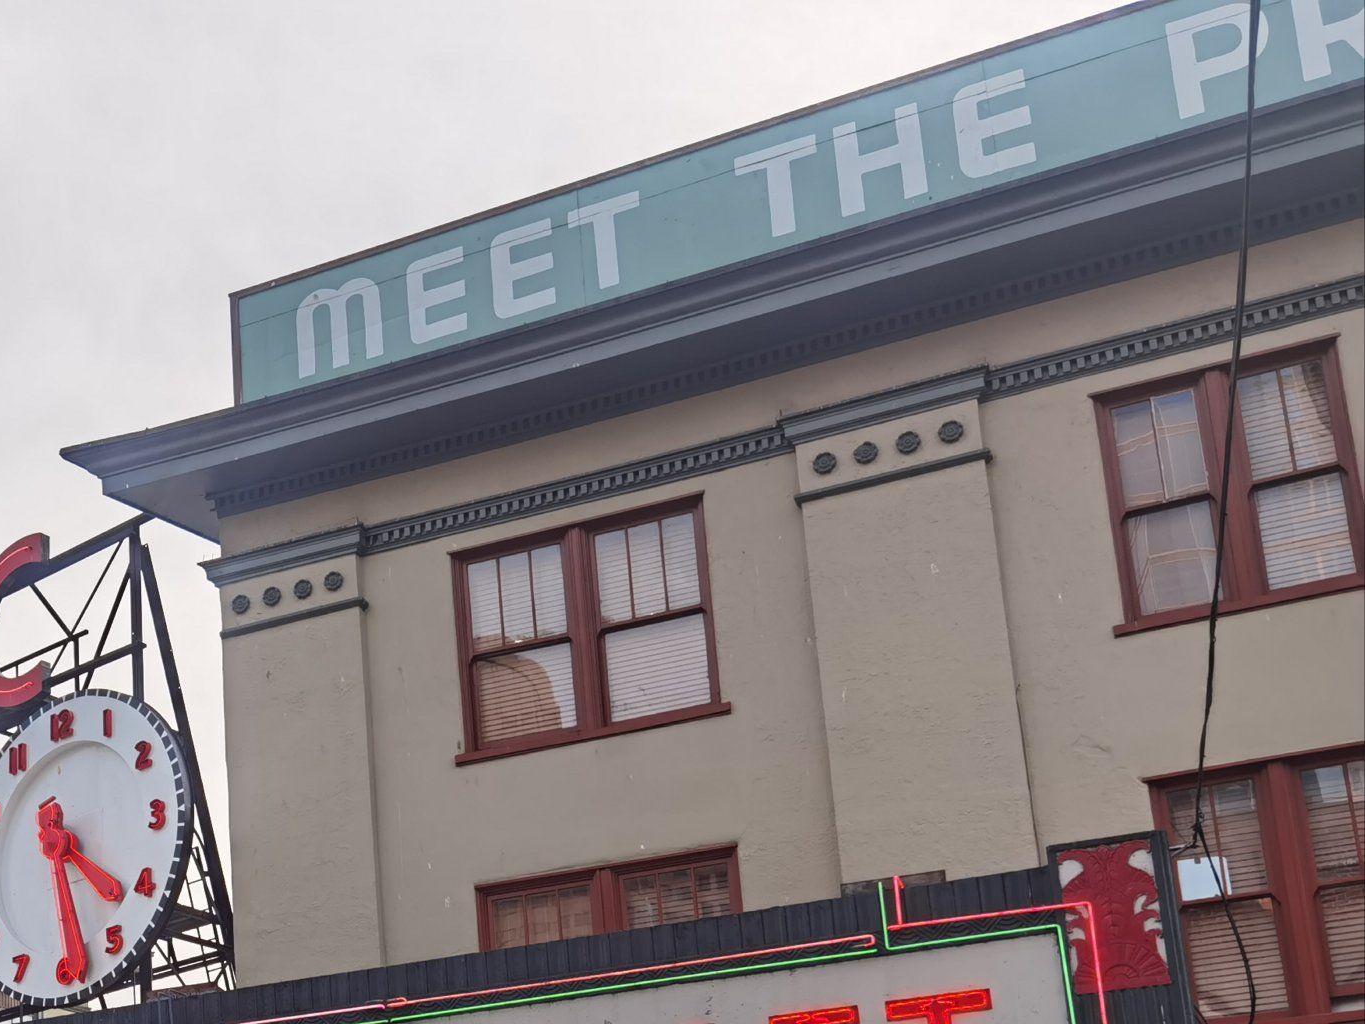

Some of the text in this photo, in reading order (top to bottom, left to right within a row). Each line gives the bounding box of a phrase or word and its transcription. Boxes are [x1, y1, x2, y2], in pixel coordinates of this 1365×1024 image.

[295, 191, 641, 378] MEET
[734, 69, 1038, 237] THE
[50, 709, 74, 742] 12
[103, 709, 112, 737] 1
[9, 743, 28, 775] 11
[134, 741, 153, 770] 2
[148, 799, 166, 830] 3
[134, 867, 156, 898] 4
[105, 925, 123, 954] 5
[12, 954, 30, 983] 7
